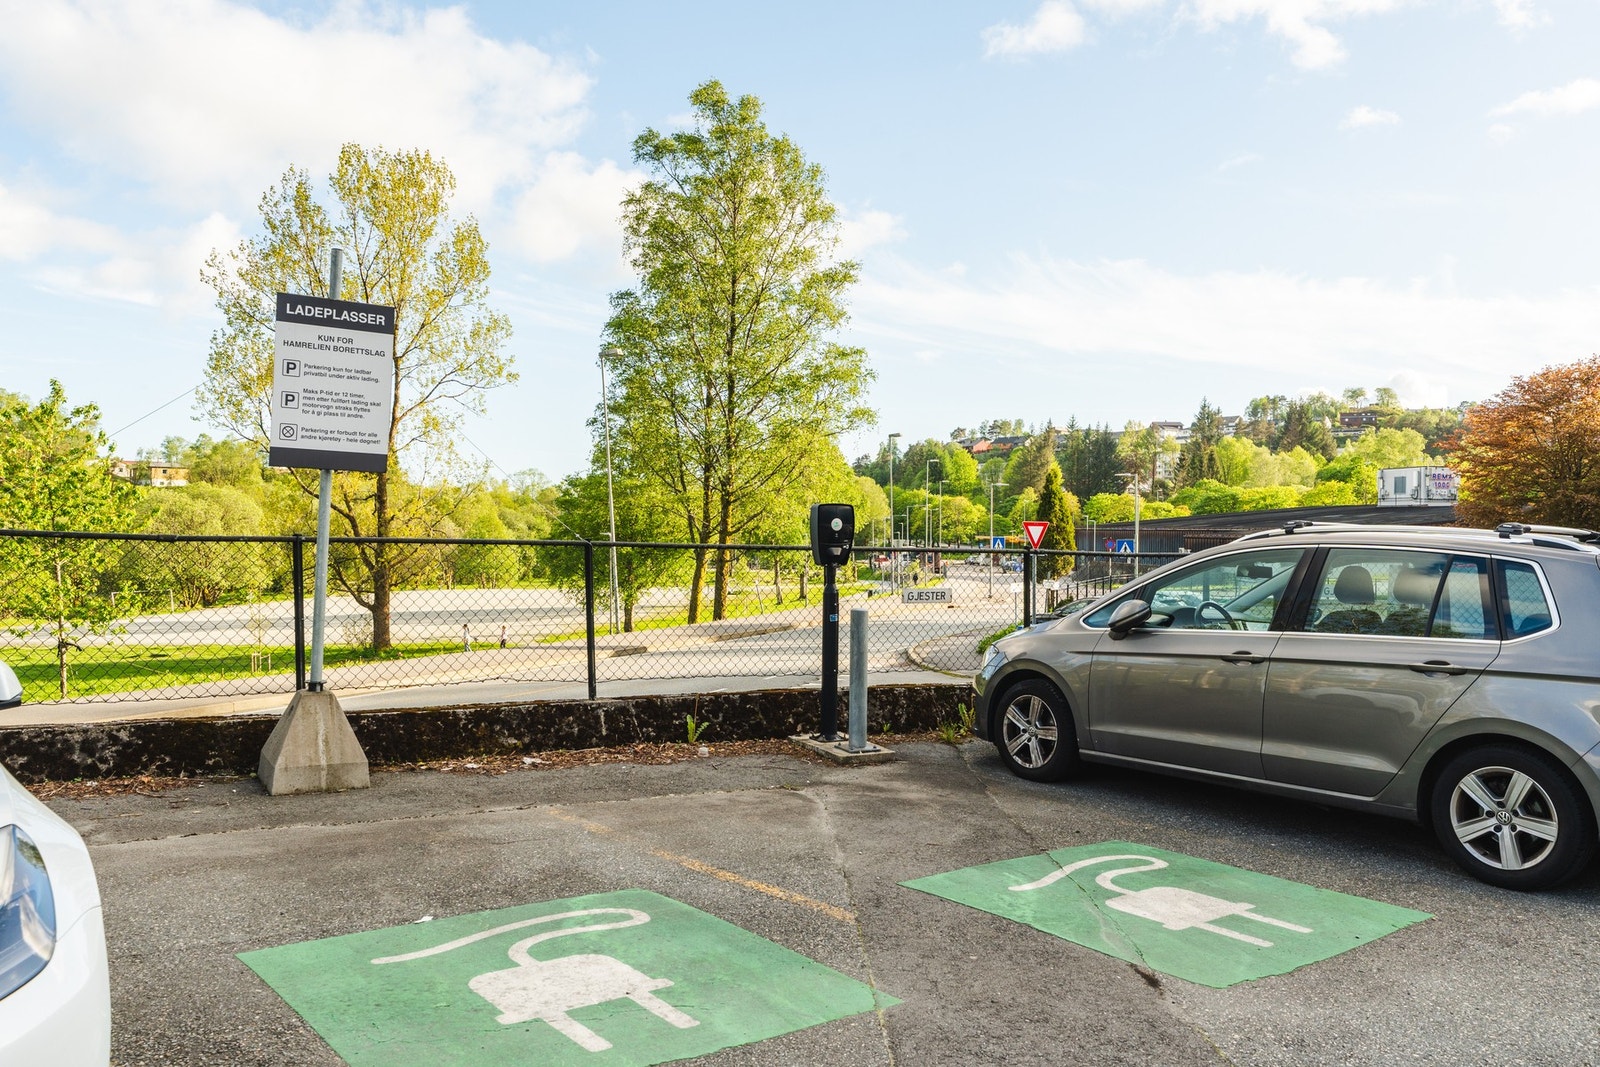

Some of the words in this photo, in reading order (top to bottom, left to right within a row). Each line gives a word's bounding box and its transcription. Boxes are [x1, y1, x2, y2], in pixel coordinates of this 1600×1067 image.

[286, 303, 385, 325] LADEPLASSER
[283, 340, 330, 350] HAMRELIEN
[333, 346, 385, 357] BORETTSLAG
[286, 362, 296, 374] P
[304, 363, 331, 372] Parkering
[285, 394, 295, 406] P
[302, 402, 333, 410] motorvogn
[301, 426, 328, 434] Parkering
[908, 592, 946, 600] GJESTER
